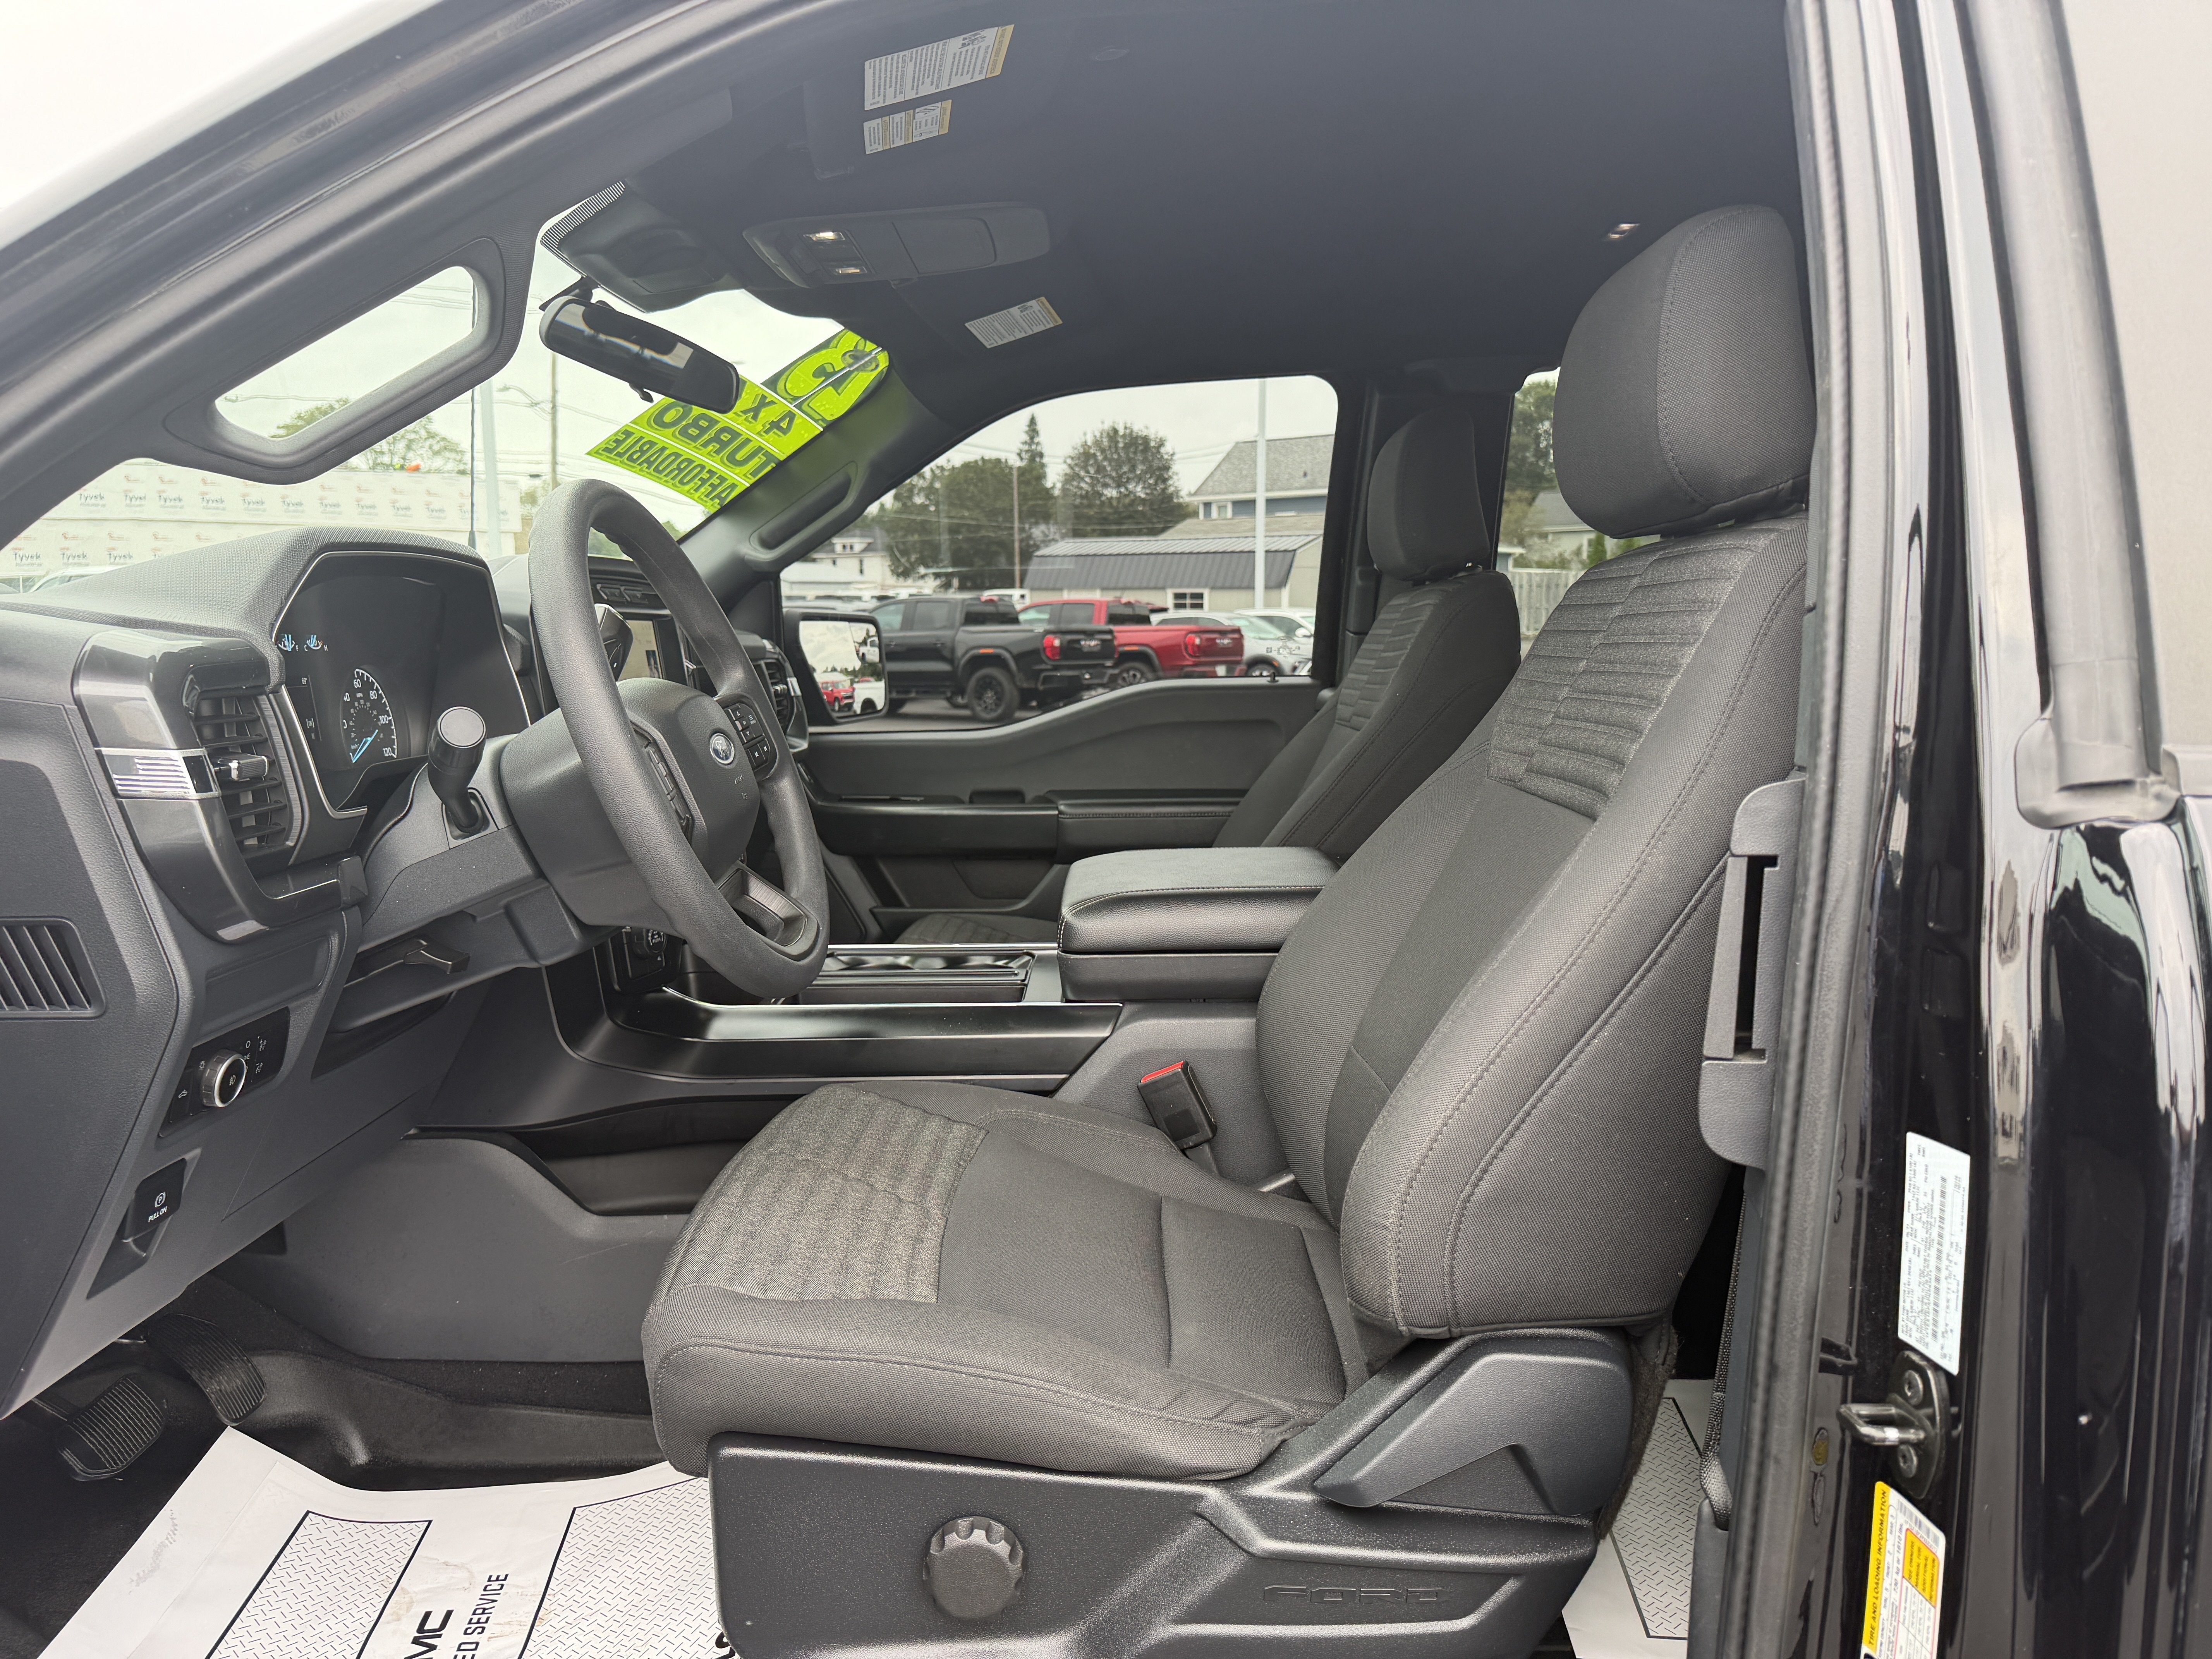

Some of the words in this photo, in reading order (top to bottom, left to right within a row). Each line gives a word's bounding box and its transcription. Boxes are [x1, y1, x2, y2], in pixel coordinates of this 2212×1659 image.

[354, 679, 361, 688] 60
[369, 690, 377, 699] 80
[379, 715, 389, 724] 100
[383, 747, 392, 757] 120
[1873, 1558, 1881, 1600] LOADING
[1877, 1489, 1887, 1555] INFORMATION
[1264, 1585, 1451, 1603] FORD
[463, 1573, 509, 1635] SERVICE
